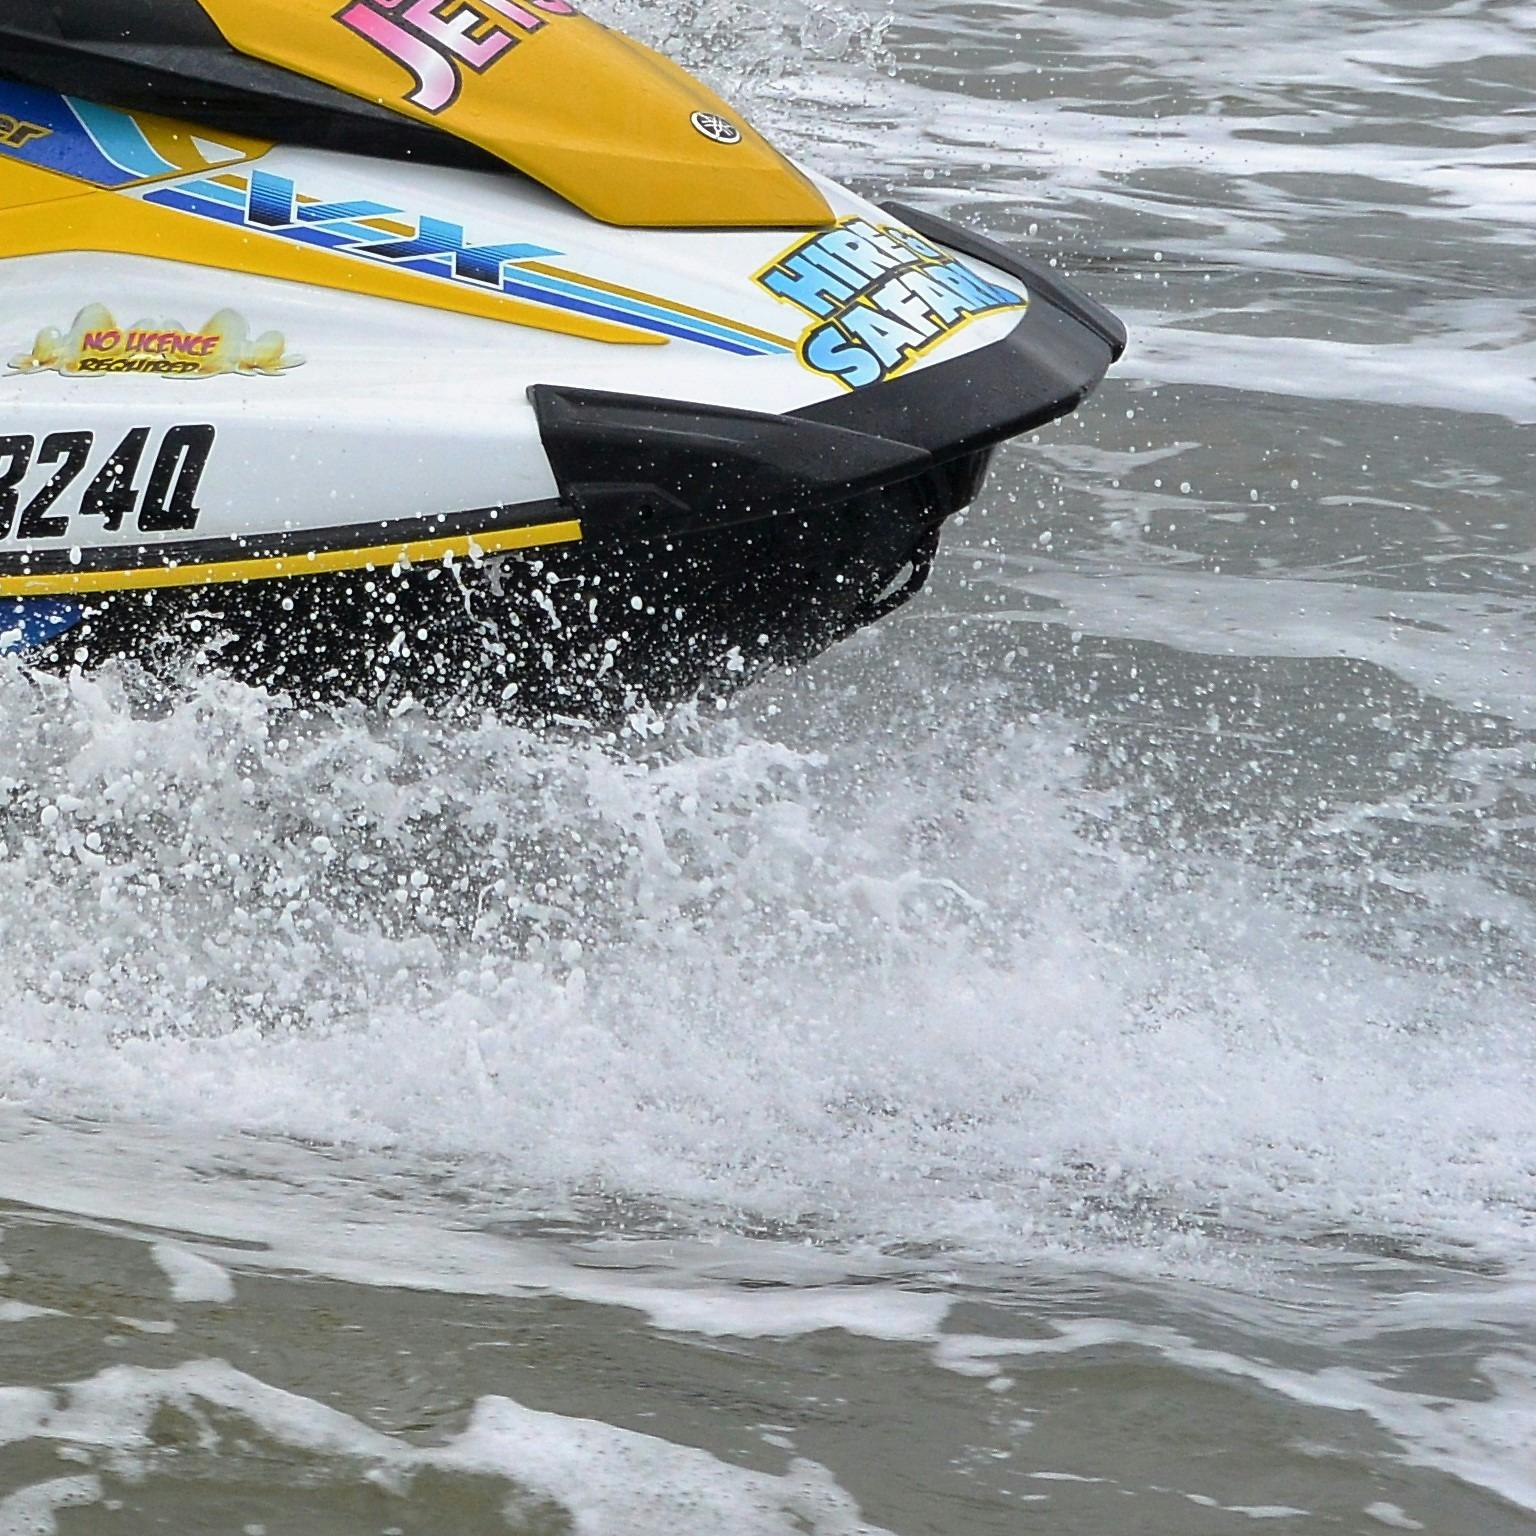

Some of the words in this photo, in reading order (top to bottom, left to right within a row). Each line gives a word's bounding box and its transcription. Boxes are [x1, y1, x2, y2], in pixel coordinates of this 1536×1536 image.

[760, 216, 923, 319] HIRE
[82, 331, 121, 352] NO
[125, 332, 221, 356] LICENCE
